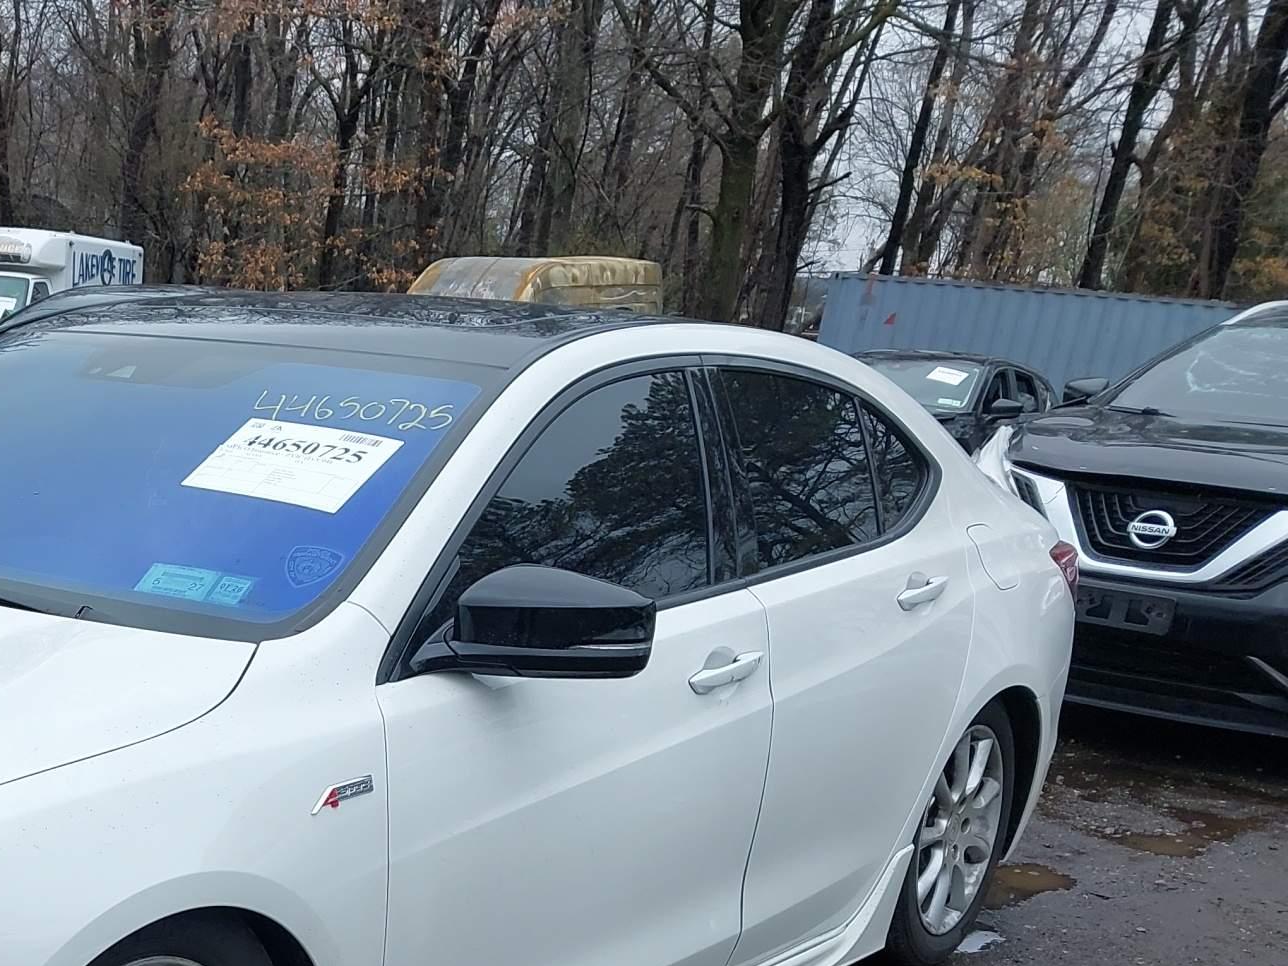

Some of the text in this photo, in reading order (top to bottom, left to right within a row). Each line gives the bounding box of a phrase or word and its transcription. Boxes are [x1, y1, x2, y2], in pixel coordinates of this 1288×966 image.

[118, 257, 137, 286] TIRE
[253, 389, 455, 431] 44650725
[244, 434, 369, 464] 44650725
[1131, 524, 1170, 535] NISSAN
